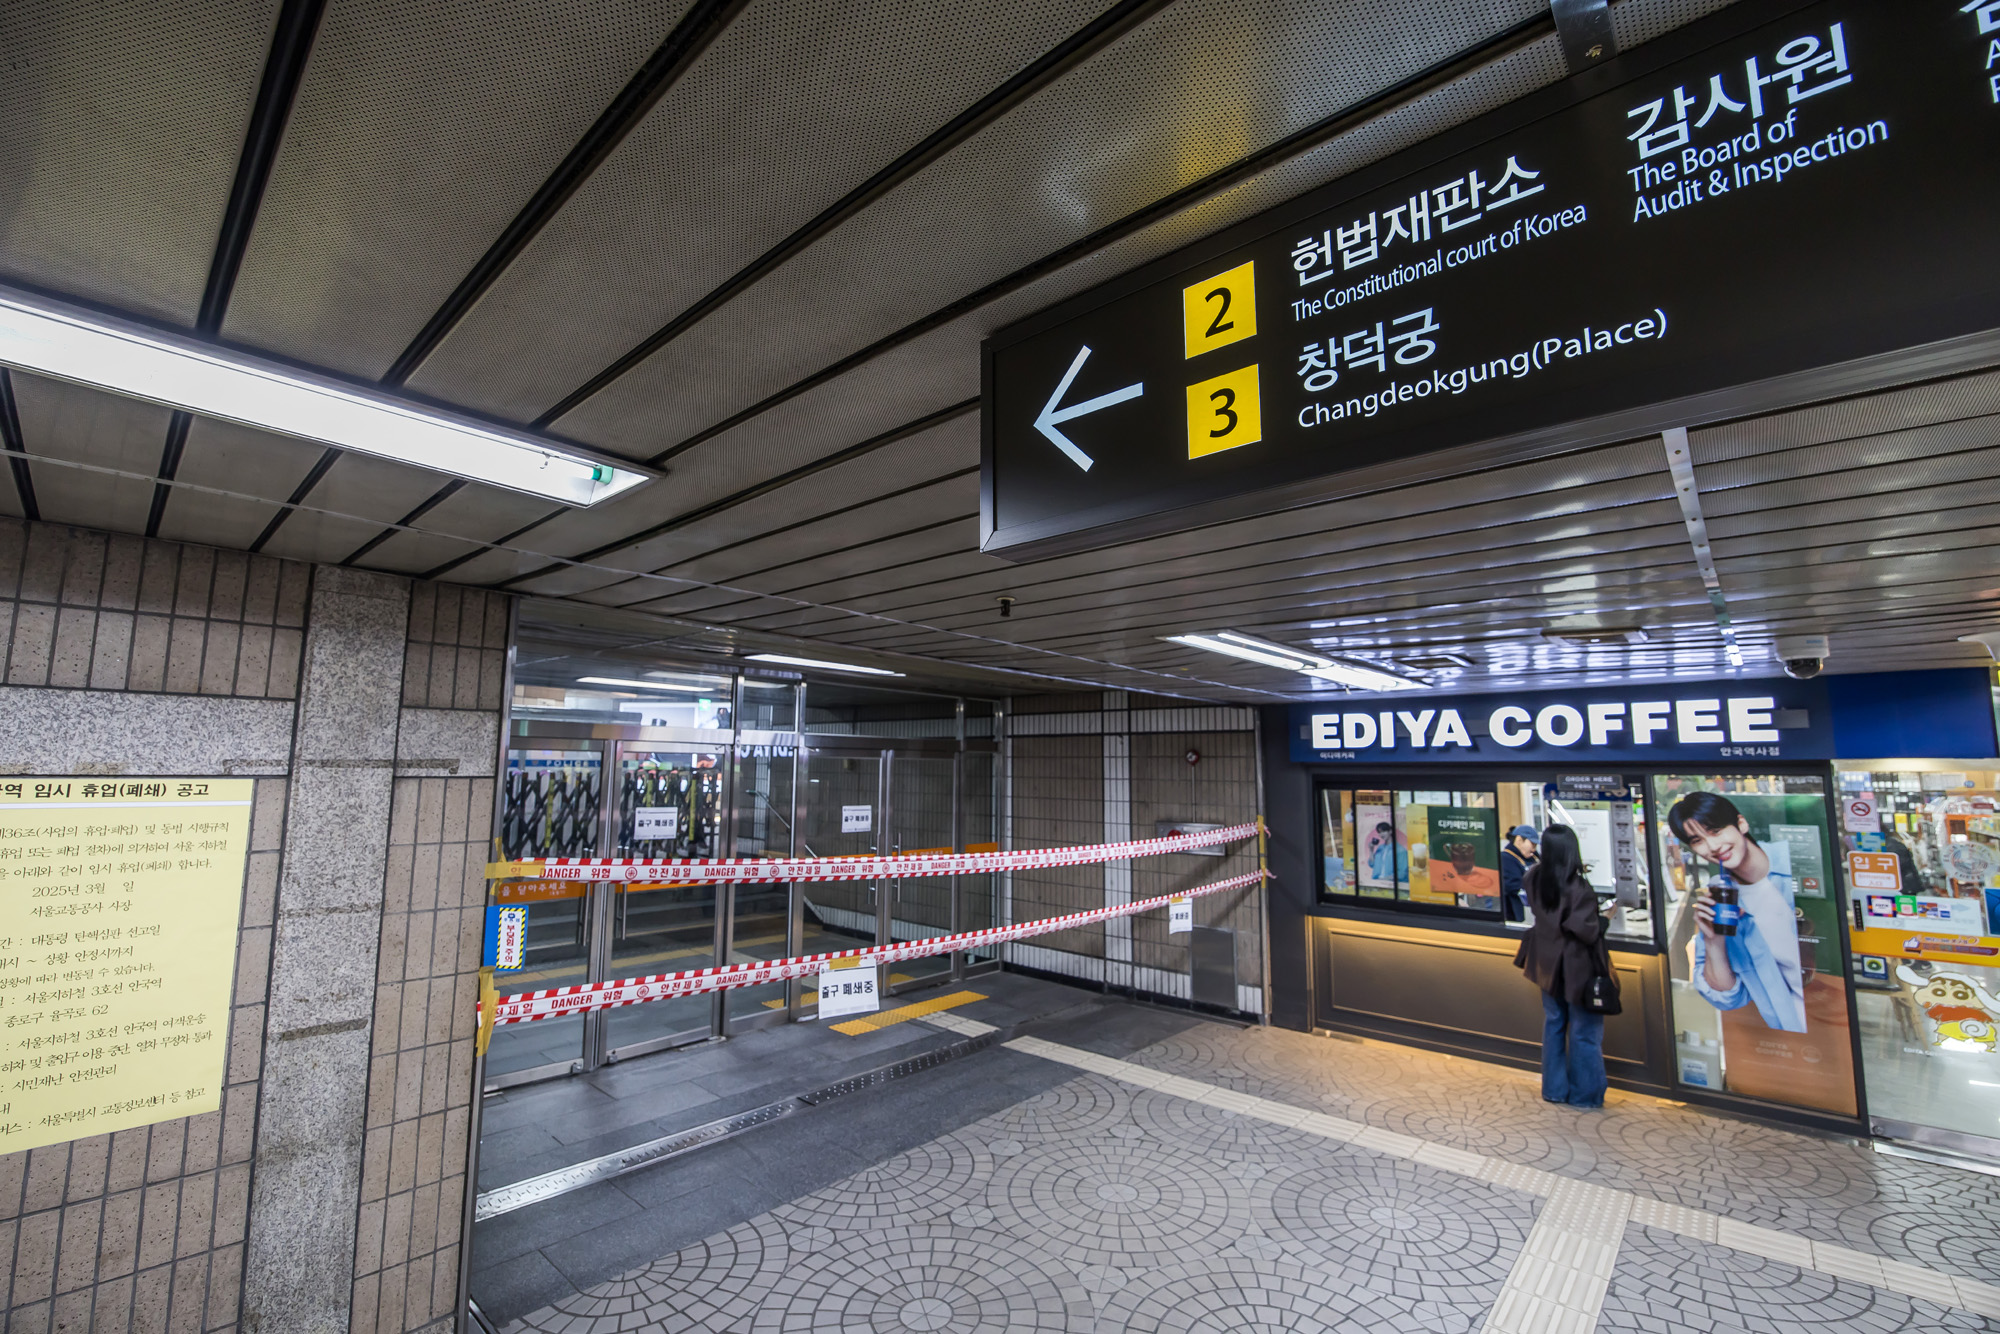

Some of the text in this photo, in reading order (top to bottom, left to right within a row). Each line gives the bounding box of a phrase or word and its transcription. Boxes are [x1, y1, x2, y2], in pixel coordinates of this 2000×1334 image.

[1627, 22, 1853, 160] 감사원
[1627, 108, 1798, 192] The Board of
[1633, 119, 1889, 223] Audit & Inspection
[1291, 156, 1545, 286] 헌법재판소
[1291, 204, 1587, 322] The Constitutional court of Korea
[1204, 287, 1235, 338] 2
[1297, 308, 1441, 392] 창덕궁
[1298, 309, 1668, 428] Changdeokgung(Palace)
[1209, 388, 1238, 438] 3
[1312, 697, 1780, 749] EDIYA COFFEE
[35, 784, 71, 798] 임시
[82, 783, 167, 797] 휴업(폐쇄)
[177, 784, 209, 797] 공고
[145, 824, 156, 835] 및
[188, 822, 229, 834] 시행규칙
[27, 847, 53, 858] 또는
[174, 841, 195, 852] 서울
[198, 840, 227, 851] 지하철
[13, 865, 54, 879] 아래와
[59, 864, 83, 877] 같이
[89, 863, 112, 875] 임시
[179, 858, 212, 870] 합니다.
[539, 868, 581, 879] DANGER
[591, 868, 611, 879] 위험
[649, 867, 692, 878] 안전제일
[704, 868, 737, 877] DANGER
[743, 867, 760, 877] 위험
[788, 865, 822, 876] 안전제일
[831, 865, 857, 875] DANGER
[862, 864, 874, 873] 위험
[32, 881, 134, 898] 2025년 3월 일
[29, 902, 104, 917] 서울교통공사
[31, 932, 68, 946] 대통령
[75, 928, 122, 943] 탄핵심판
[127, 924, 161, 938] 선고일
[44, 952, 70, 966] 상황
[74, 945, 134, 962] 안정시까지
[36, 972, 58, 984] 따라
[98, 967, 110, 977] 수
[114, 962, 155, 976] 있습니다.
[24, 986, 85, 1004] 서울지하철
[91, 982, 123, 997] 3호선
[129, 978, 162, 992] 안국역
[551, 994, 593, 1009] DANGER
[603, 990, 623, 1001] 위험
[661, 979, 703, 993] 안전제일
[716, 973, 748, 985] DANGER
[756, 969, 771, 979] 위험
[822, 981, 873, 999] 출구 폐쇄중
[4, 1005, 108, 1028] 종로구 율곡로 62
[18, 1031, 80, 1050] 서울지하철
[86, 1025, 118, 1040] 3호선
[124, 1020, 157, 1035] 안국역
[163, 1013, 207, 1028] 여객운송
[30, 1056, 41, 1069] 및
[45, 1051, 80, 1067] 출입구
[82, 1047, 105, 1060] 이용
[12, 1073, 64, 1091] 시민재난
[70, 1064, 117, 1082] 안전관리
[39, 1106, 96, 1127] 서울특별시
[101, 1094, 165, 1115] 교통정보센터
[169, 1091, 181, 1103] 등
[185, 1088, 205, 1100] 참고
